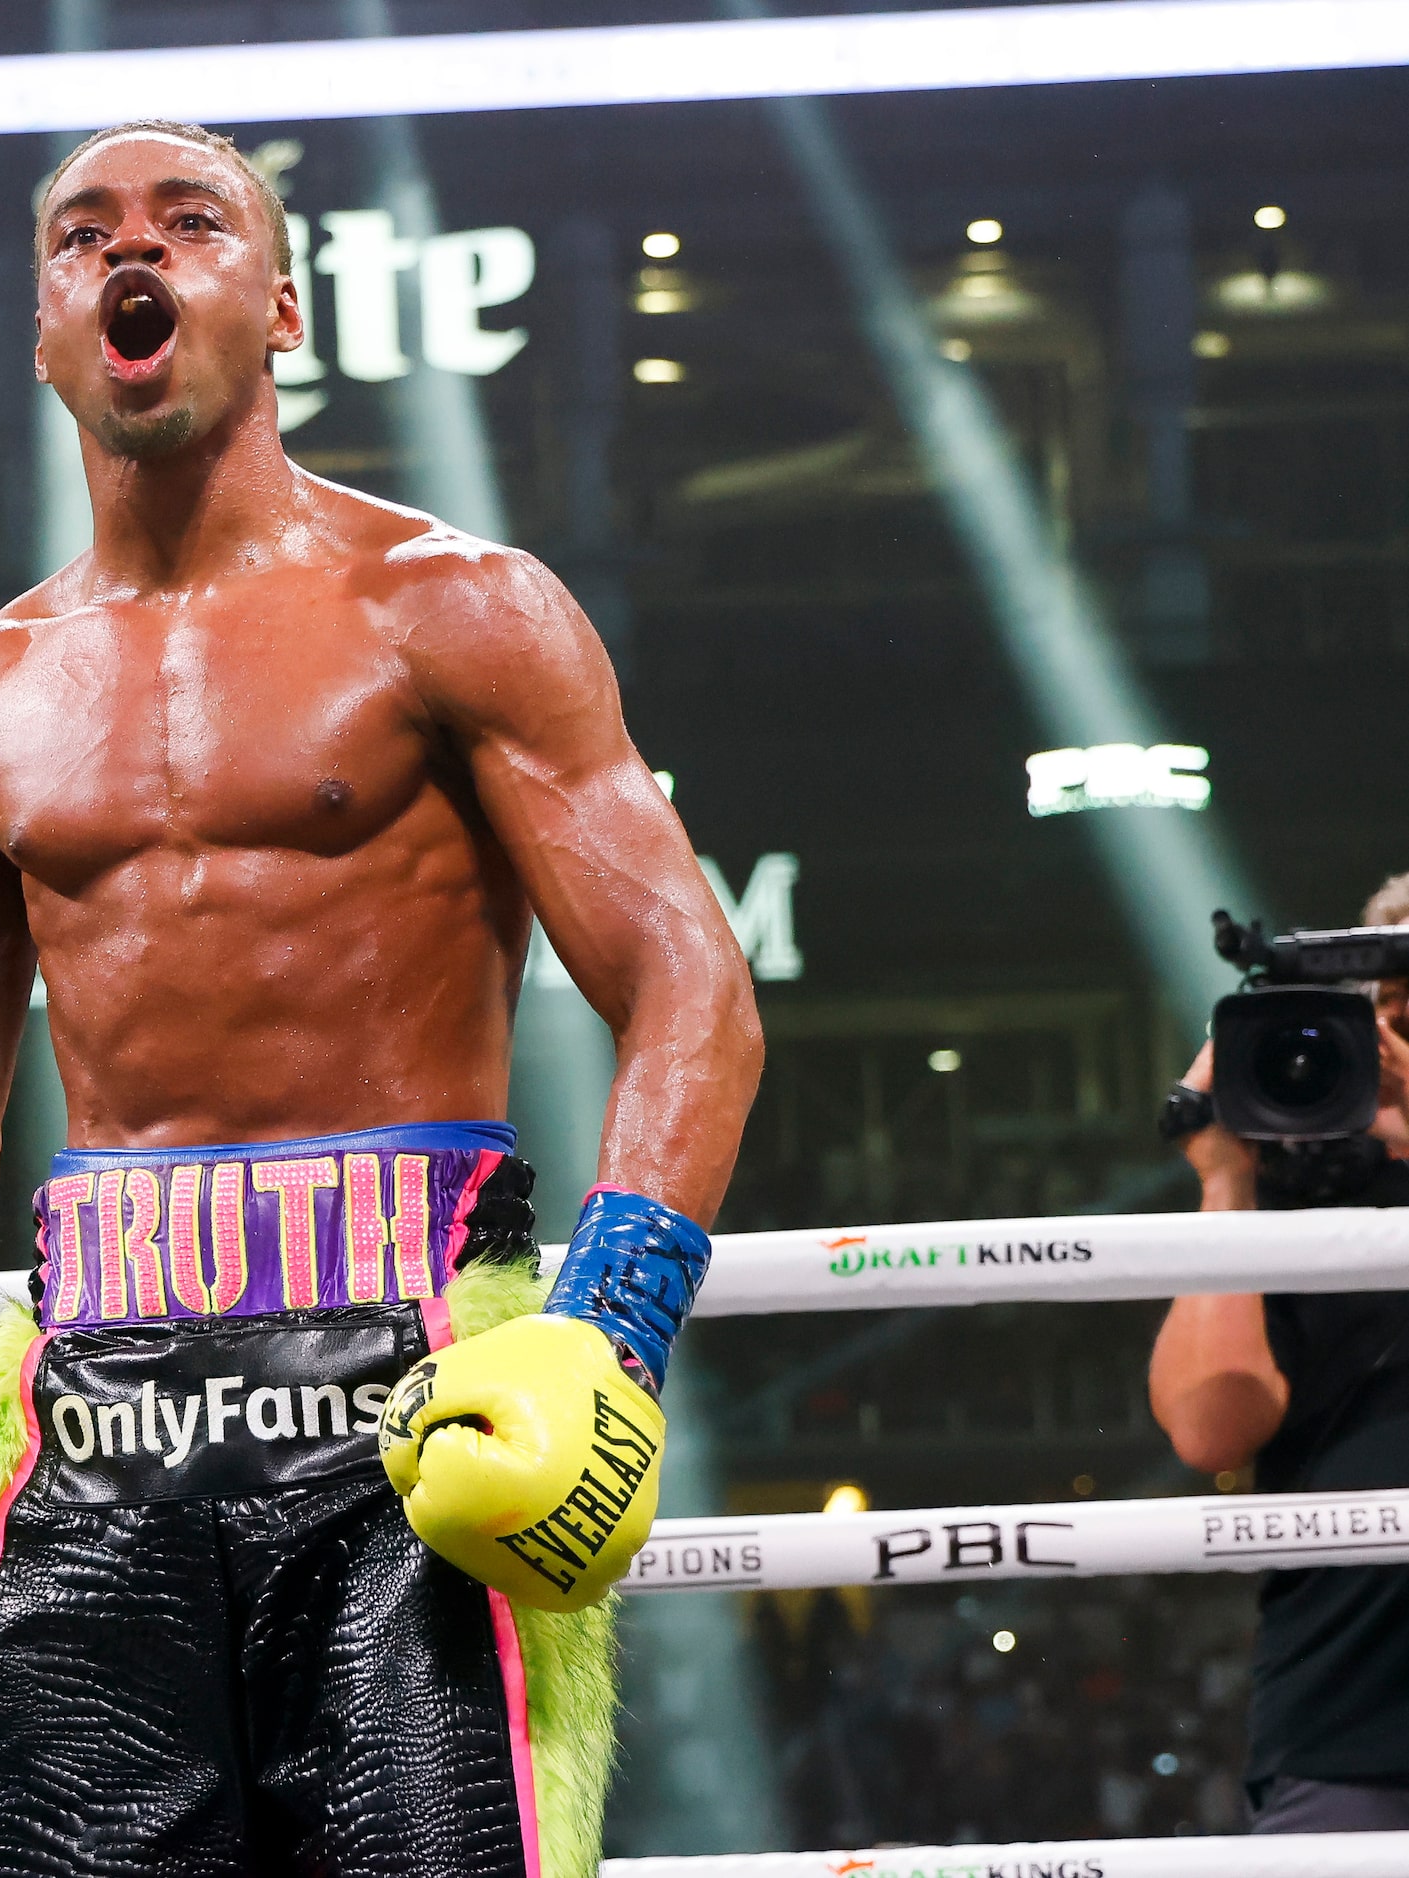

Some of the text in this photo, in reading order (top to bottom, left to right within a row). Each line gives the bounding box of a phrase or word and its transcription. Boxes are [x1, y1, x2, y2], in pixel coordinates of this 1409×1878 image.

[273, 212, 537, 433] ite
[48, 1152, 434, 1321] TRUTH
[829, 1239, 1094, 1277] DRAFTKINGS
[51, 1375, 392, 1468] OnlyFans
[495, 1388, 658, 1595] EVERLAST
[1203, 1505, 1402, 1544] PREMIER
[629, 1544, 763, 1577] PIONS
[873, 1521, 1078, 1581] PBC
